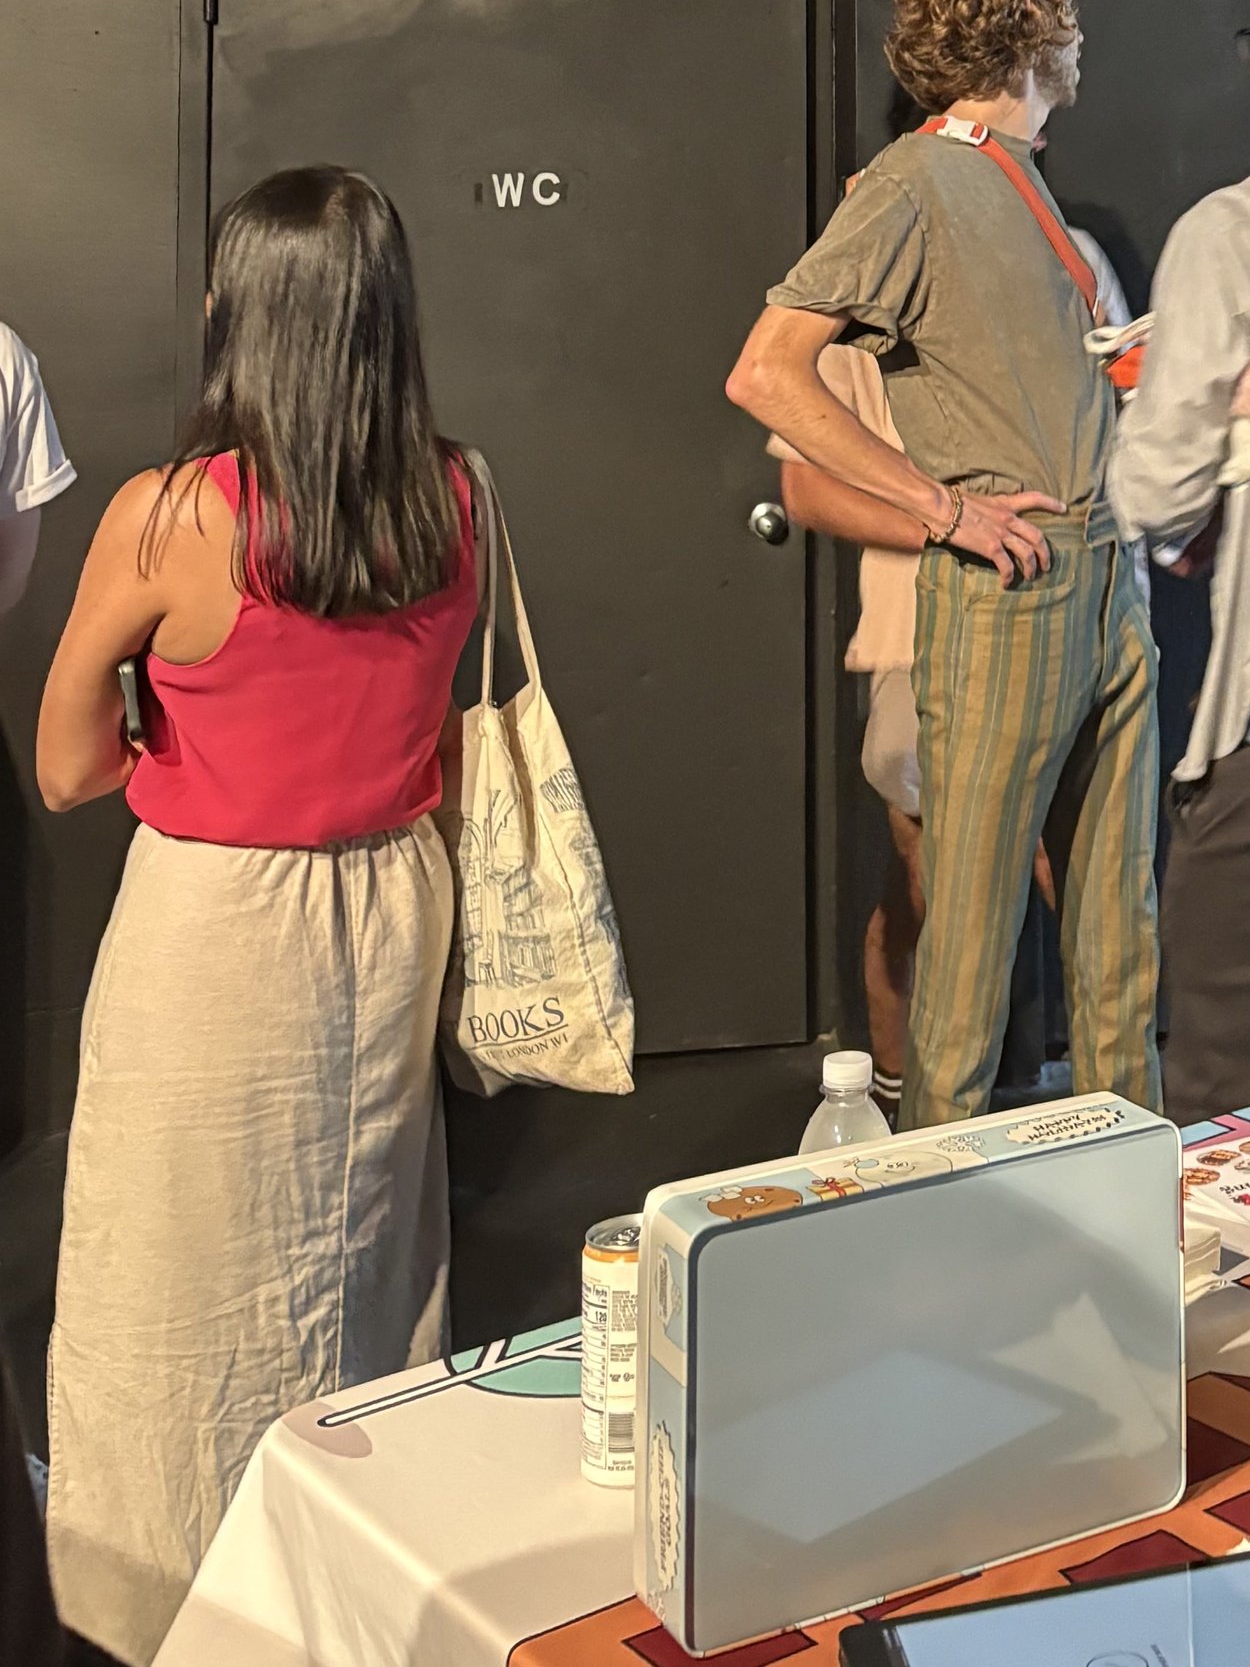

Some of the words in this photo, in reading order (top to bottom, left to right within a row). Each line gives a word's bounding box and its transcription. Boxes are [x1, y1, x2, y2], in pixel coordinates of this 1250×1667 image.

[492, 172, 560, 207] WC
[467, 995, 565, 1043] BOOKS
[506, 1039, 549, 1059] LONDON
